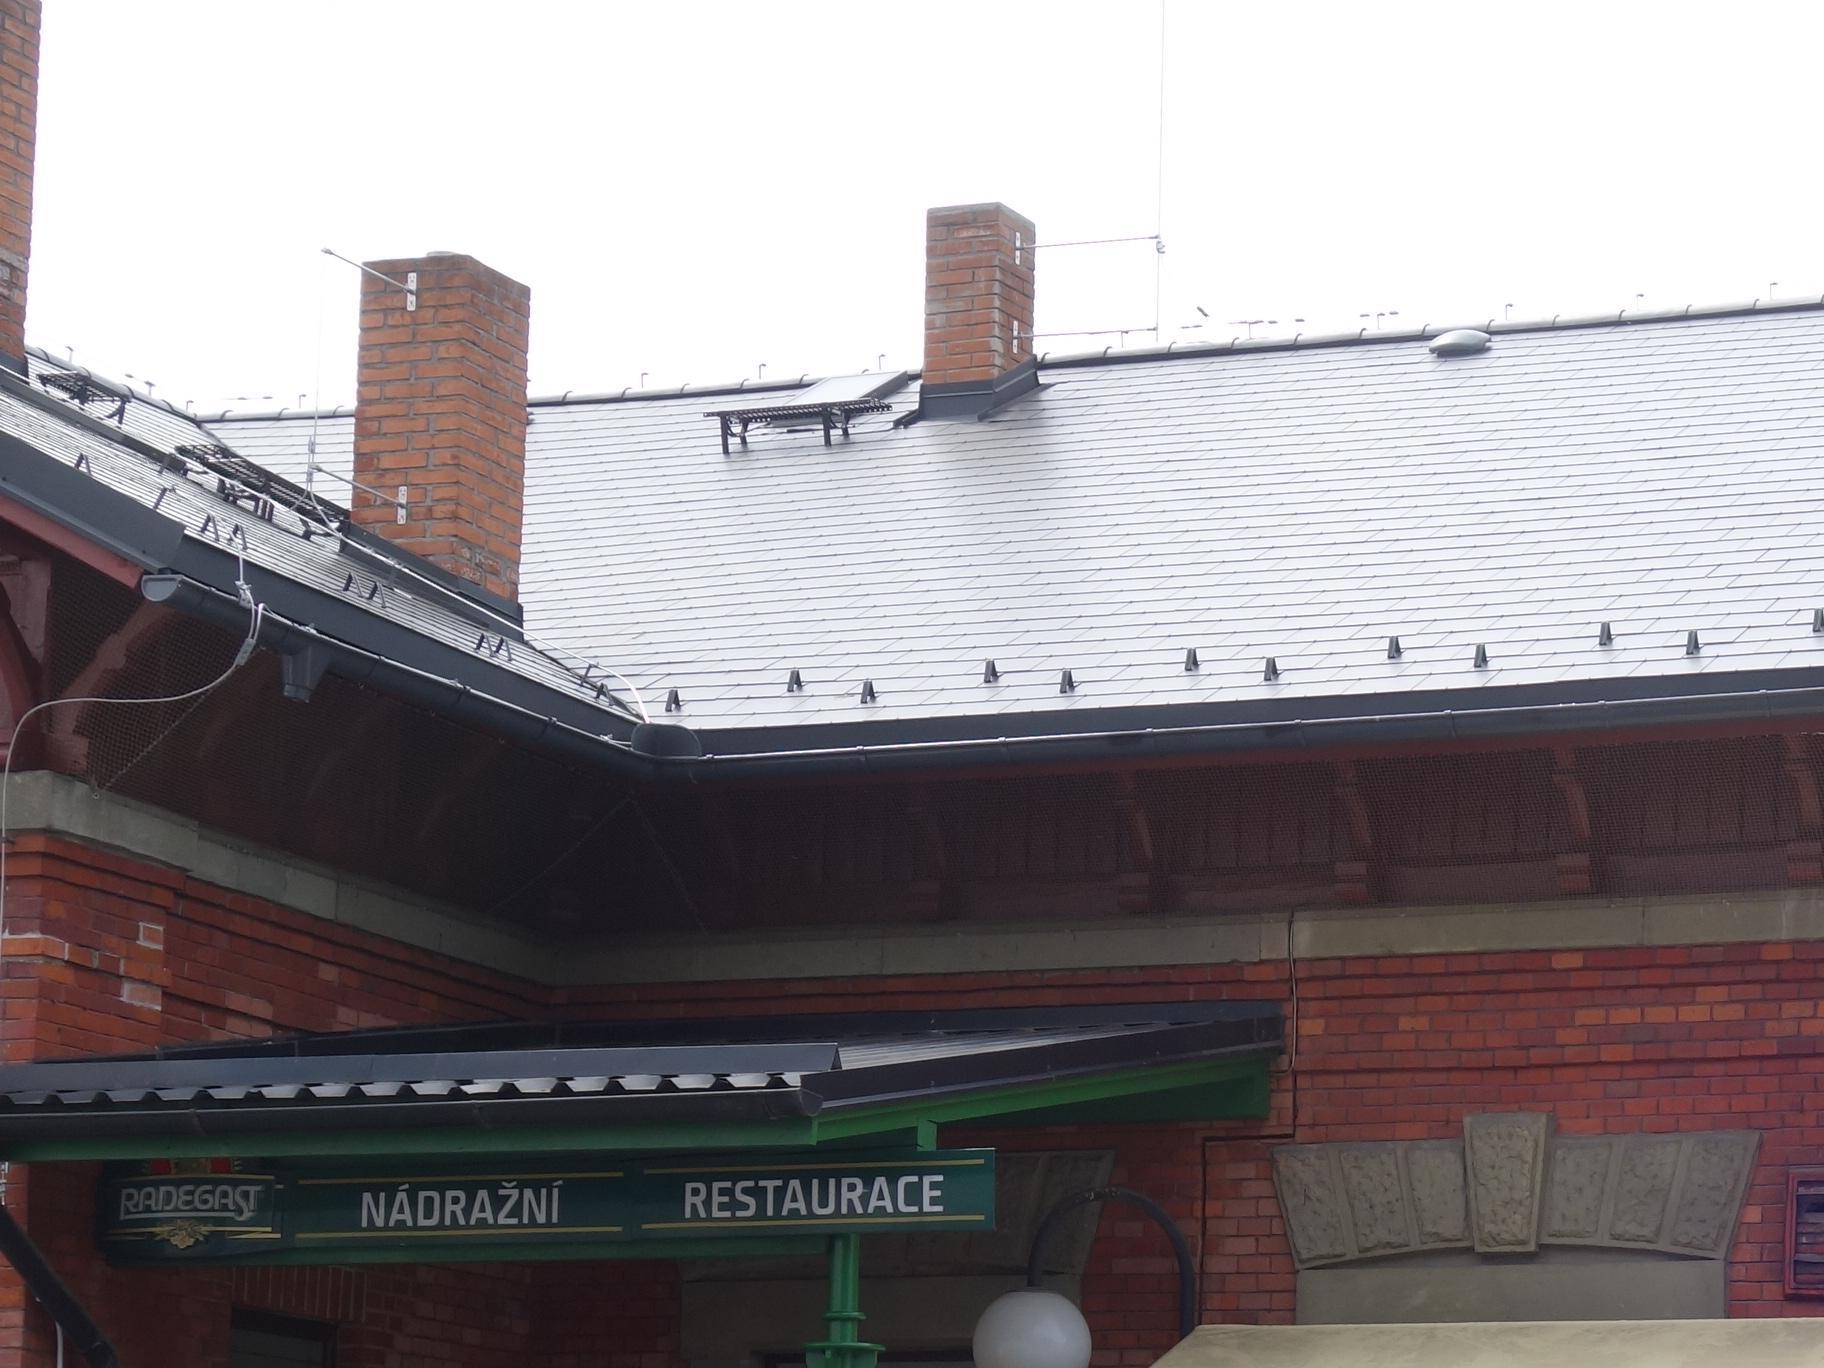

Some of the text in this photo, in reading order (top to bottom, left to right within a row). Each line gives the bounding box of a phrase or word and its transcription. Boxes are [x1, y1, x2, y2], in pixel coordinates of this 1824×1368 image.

[119, 1183, 264, 1223] RADEGAST
[360, 1174, 945, 1228] NÁDRAŽNÍ RESTAURACE
